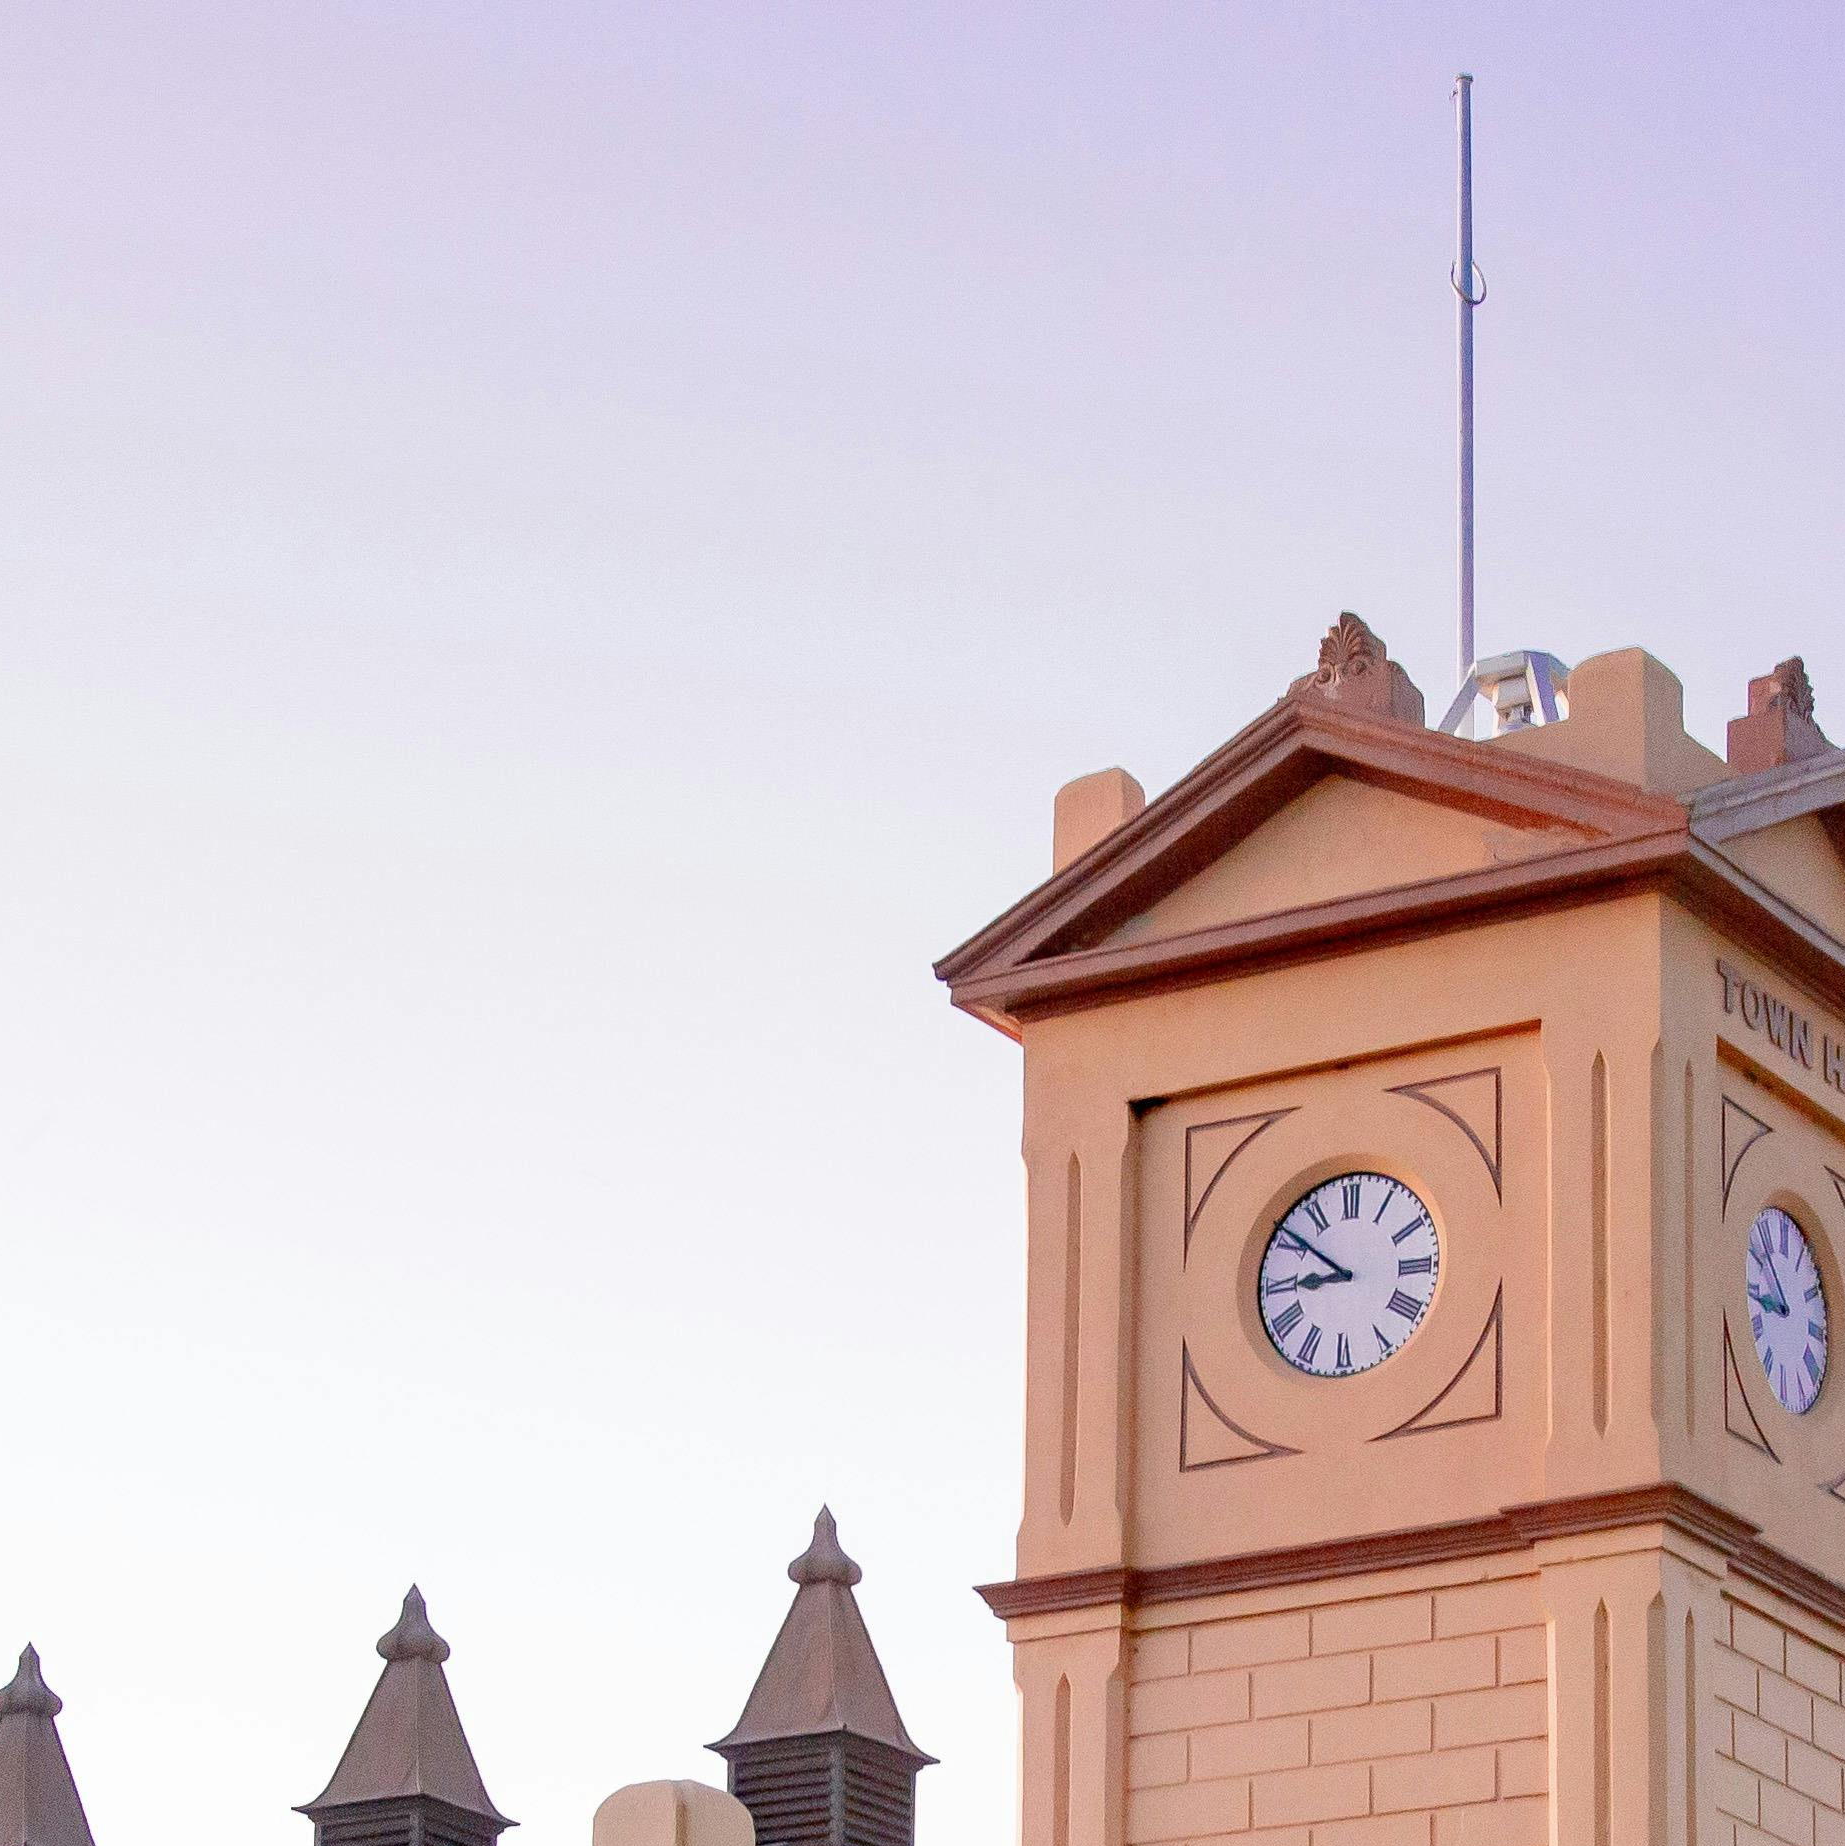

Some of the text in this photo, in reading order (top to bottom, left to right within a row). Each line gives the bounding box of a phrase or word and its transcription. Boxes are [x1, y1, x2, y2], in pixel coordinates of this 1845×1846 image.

[1716, 959, 1812, 1070] TOWN
[1302, 1199, 1331, 1237] XI
[1372, 1189, 1394, 1225] I
[1391, 1215, 1425, 1247] II
[1398, 1255, 1432, 1277] III
[1296, 1321, 1323, 1365] VII
[1335, 1332, 1353, 1369] VI
[1372, 1323, 1394, 1354] V
